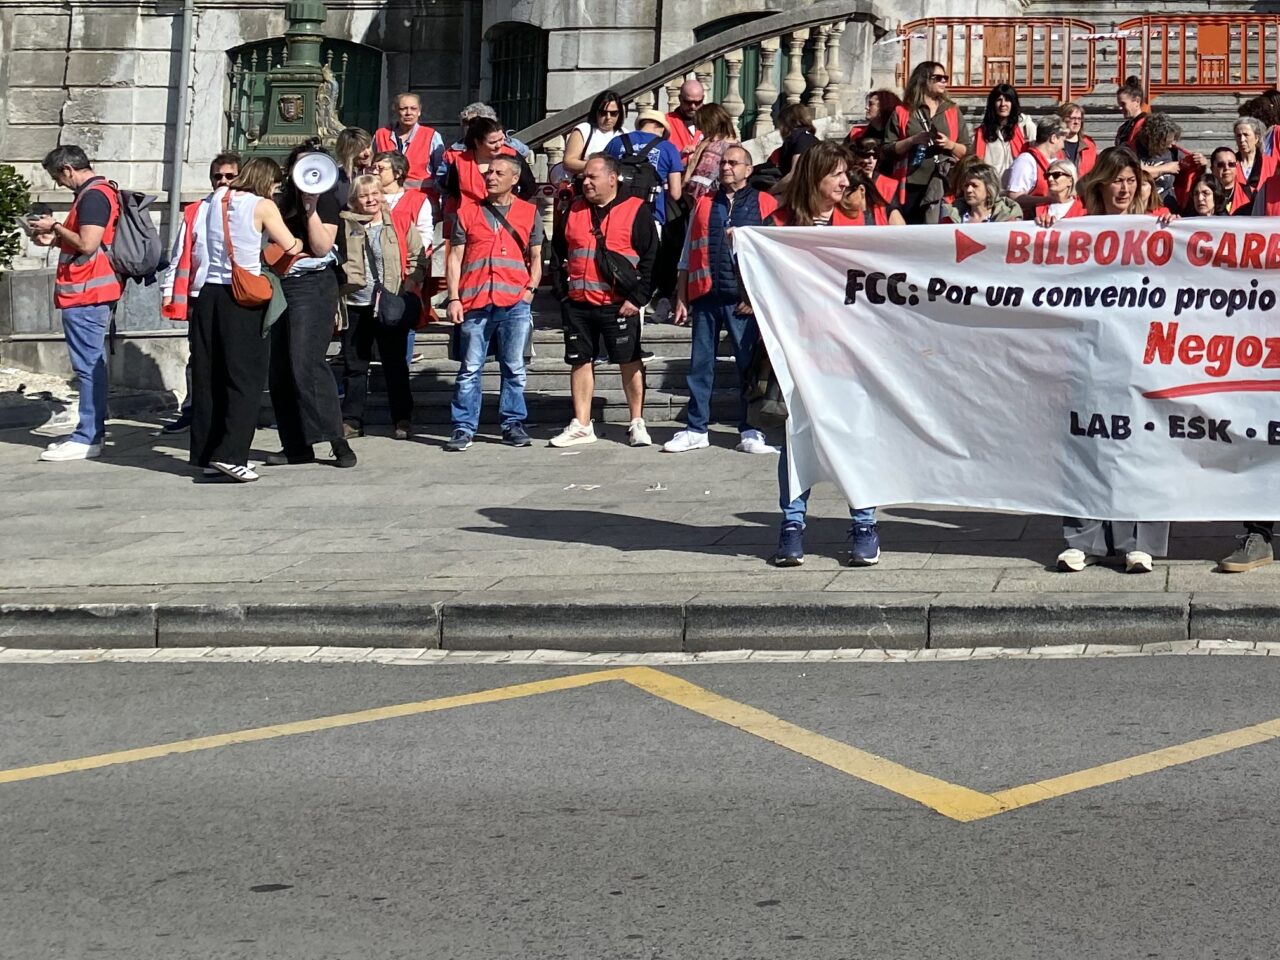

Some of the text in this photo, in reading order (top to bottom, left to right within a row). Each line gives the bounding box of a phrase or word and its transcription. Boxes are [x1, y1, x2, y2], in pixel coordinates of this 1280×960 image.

[1005, 230, 1174, 266] BILBOKO
[844, 269, 1277, 317] FCC: Por un convenio propio
[1070, 411, 1132, 440] LAB
[1168, 415, 1232, 443] ESK
